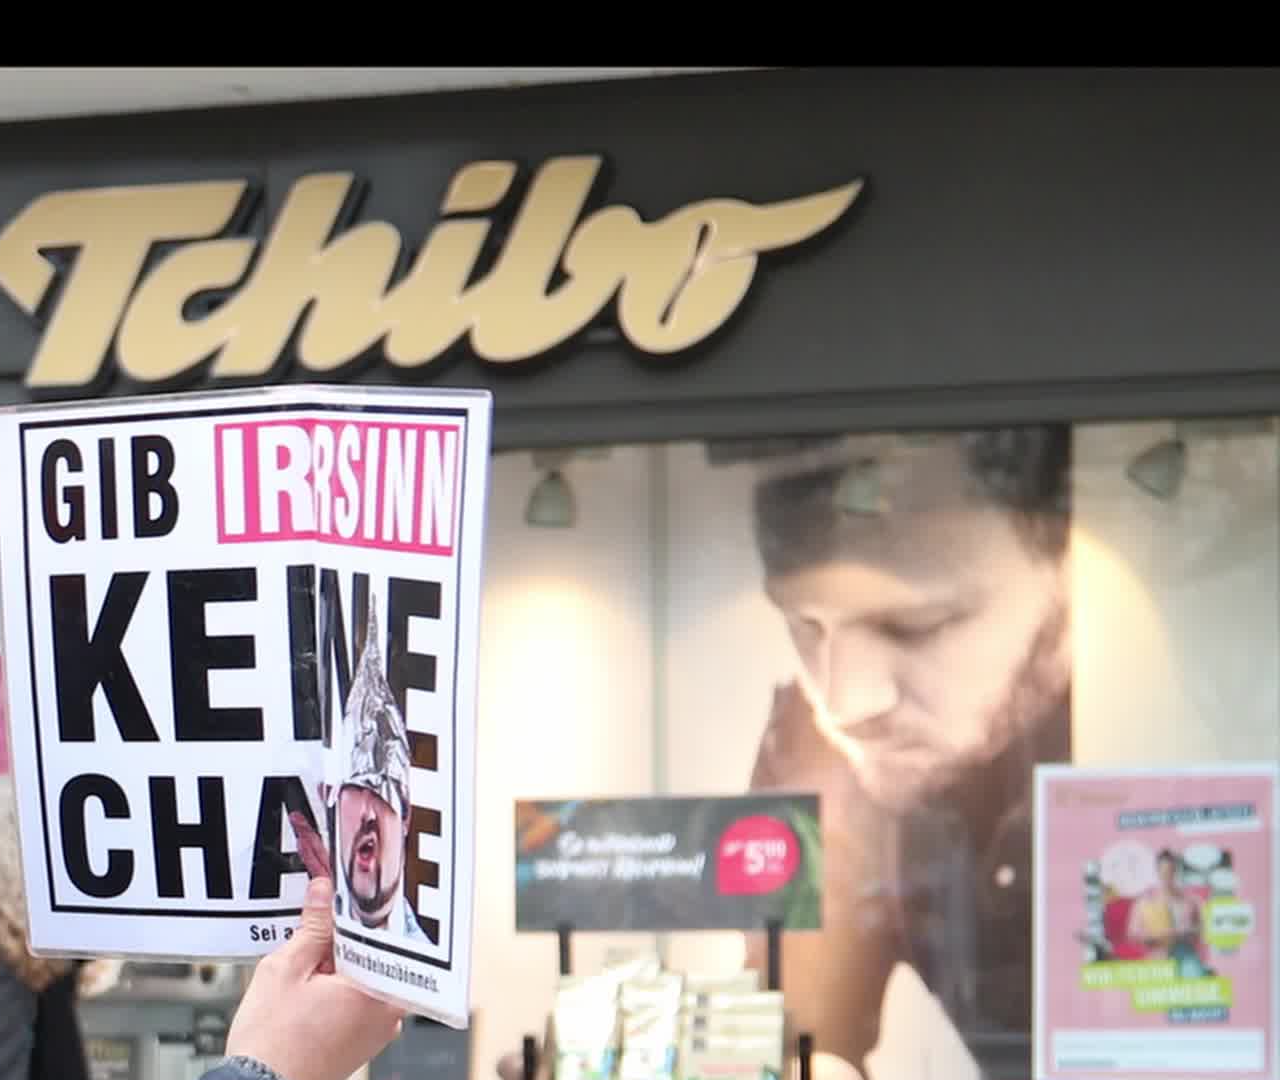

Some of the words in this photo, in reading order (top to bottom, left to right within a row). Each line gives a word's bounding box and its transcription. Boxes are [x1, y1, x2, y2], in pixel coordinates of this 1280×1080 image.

[40, 433, 180, 545] GIB
[222, 423, 458, 549] IRRSINN
[48, 563, 443, 773] KEINE
[58, 773, 442, 947] CHAE
[249, 924, 277, 942] Sei
